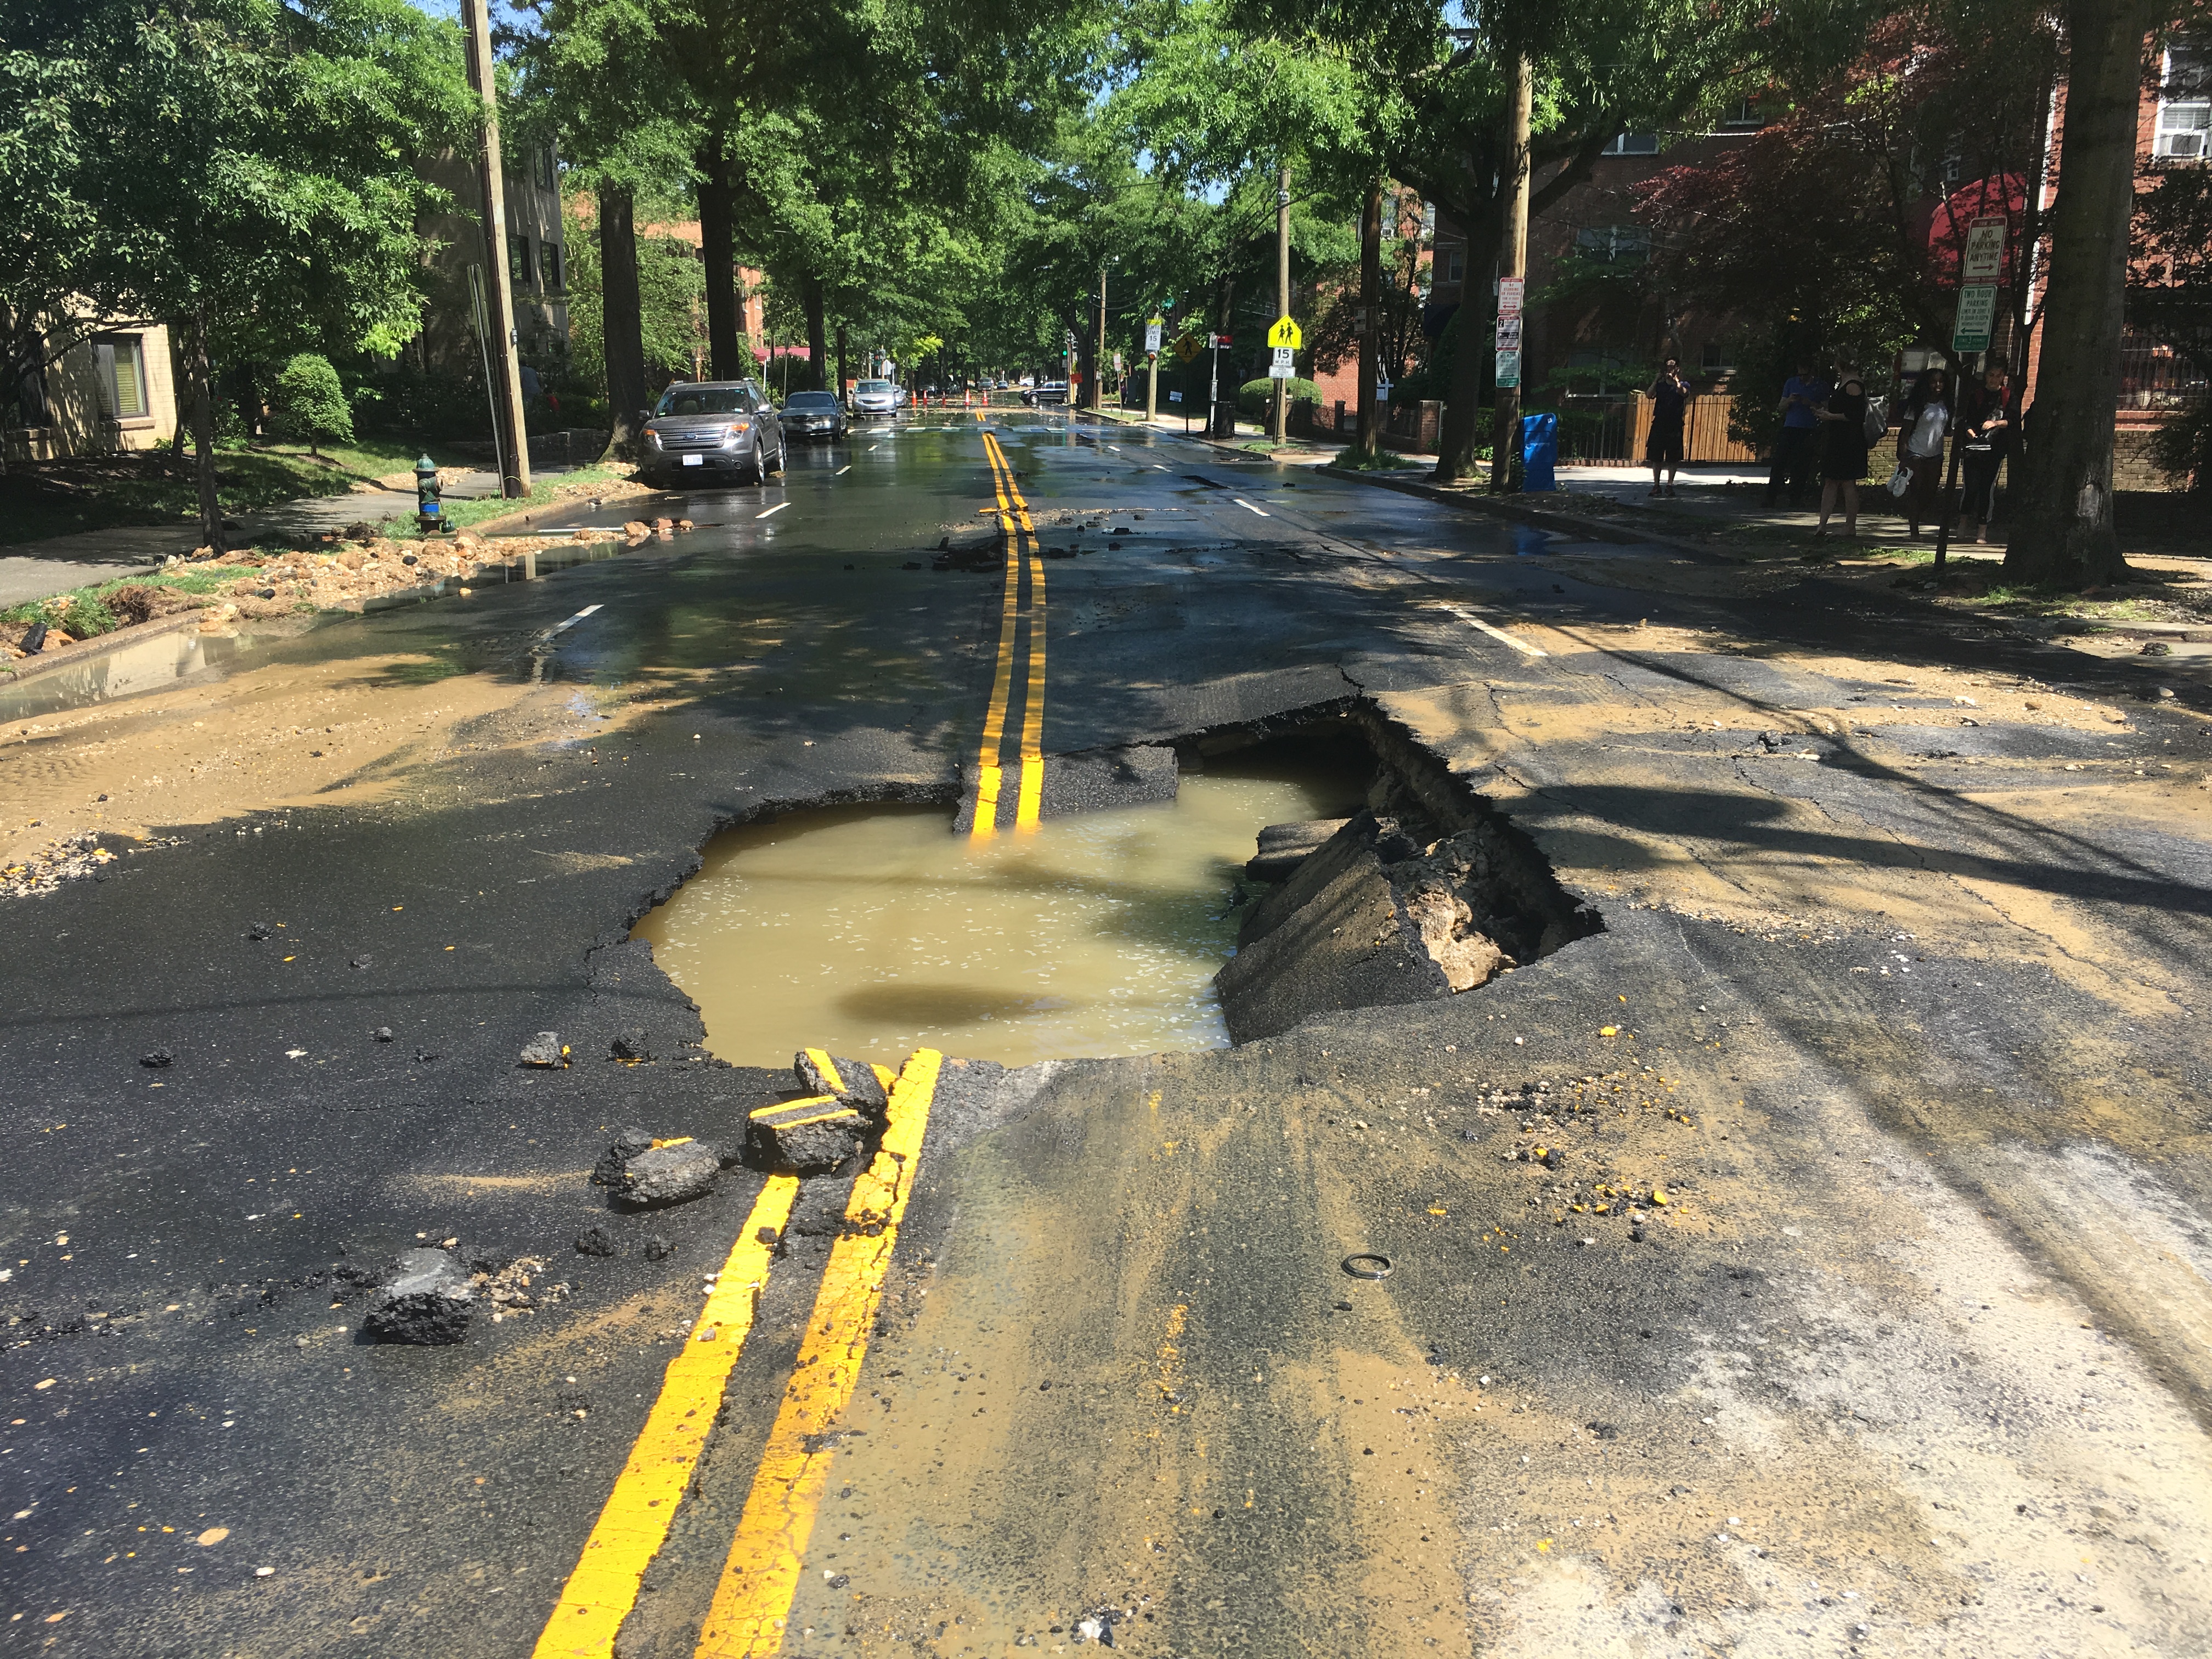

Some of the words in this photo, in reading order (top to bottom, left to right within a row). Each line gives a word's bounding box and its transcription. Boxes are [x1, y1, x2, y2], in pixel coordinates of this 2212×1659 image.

[1982, 229, 1993, 239] NO
[1971, 240, 2000, 250] PARKING
[1970, 252, 1999, 262] ANYTIME
[1977, 289, 1991, 298] HOUR
[1278, 349, 1289, 359] 15
